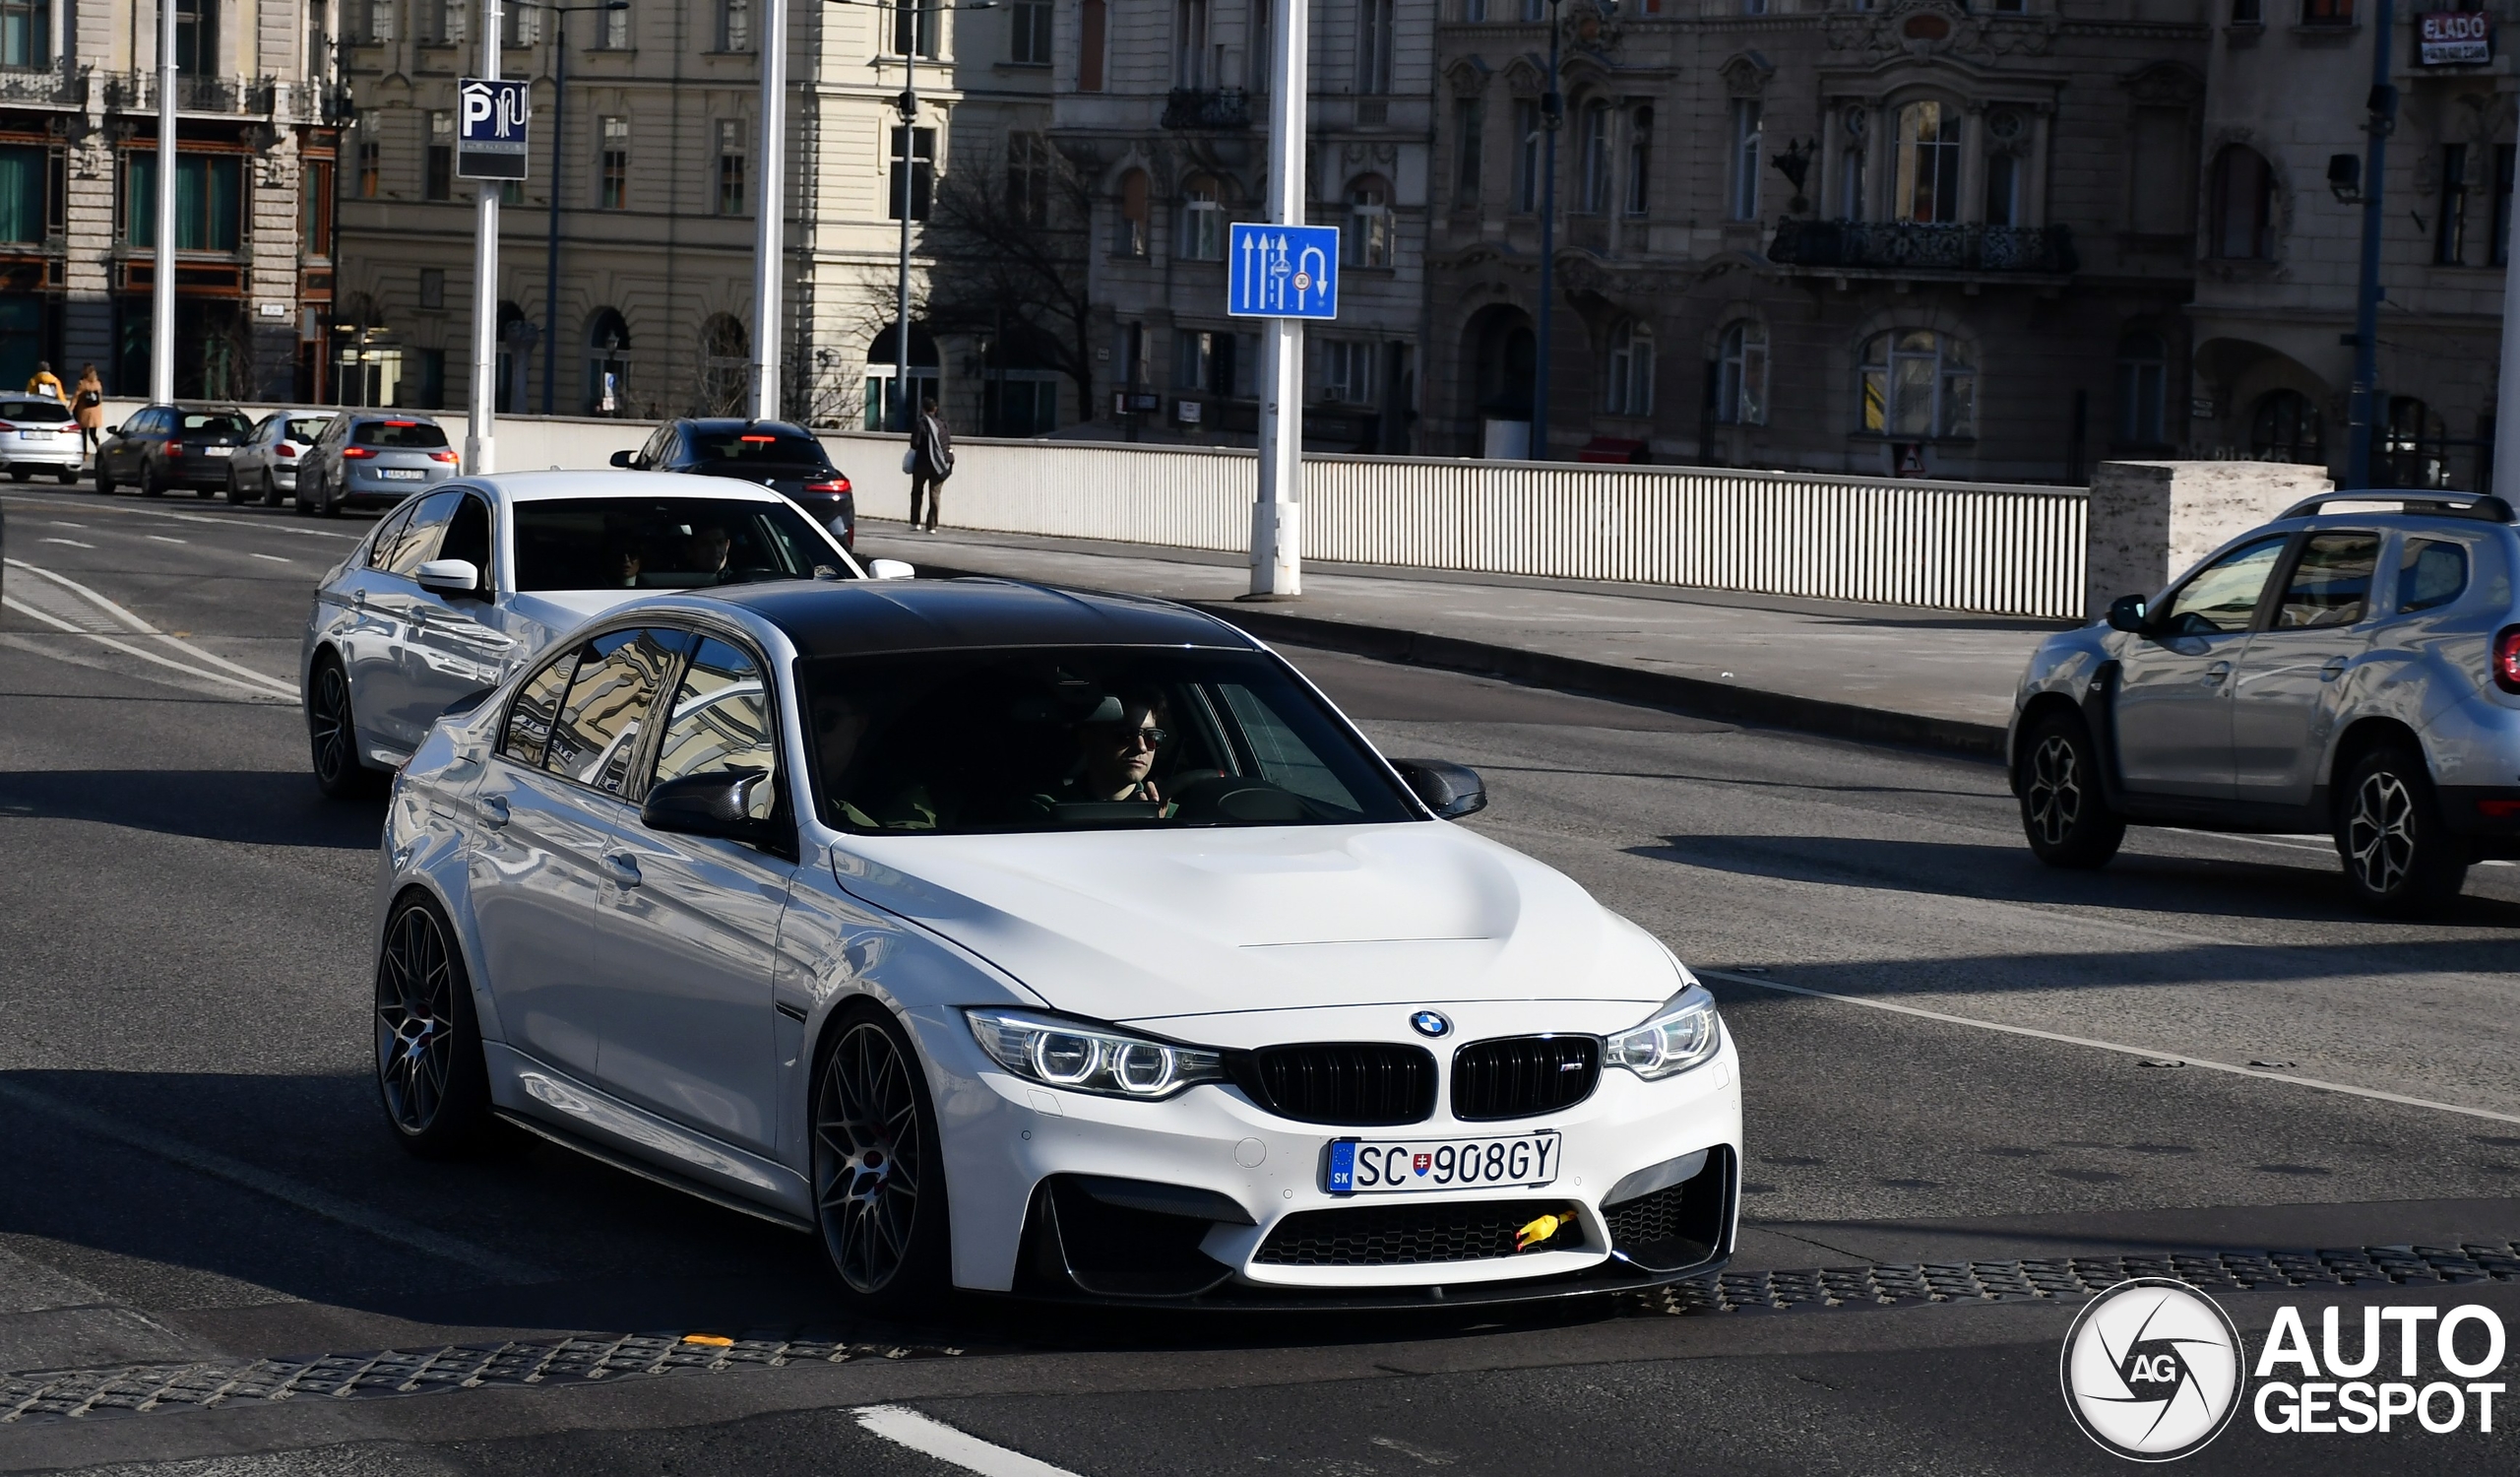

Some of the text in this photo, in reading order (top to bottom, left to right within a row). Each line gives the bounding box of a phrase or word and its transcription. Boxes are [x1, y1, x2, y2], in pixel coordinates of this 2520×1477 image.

[2424, 12, 2486, 39] ELADÓ
[463, 93, 492, 137] P
[1297, 277, 1307, 286] 30
[1357, 1137, 1554, 1187] SC 908GY
[1334, 1172, 1349, 1184] SK
